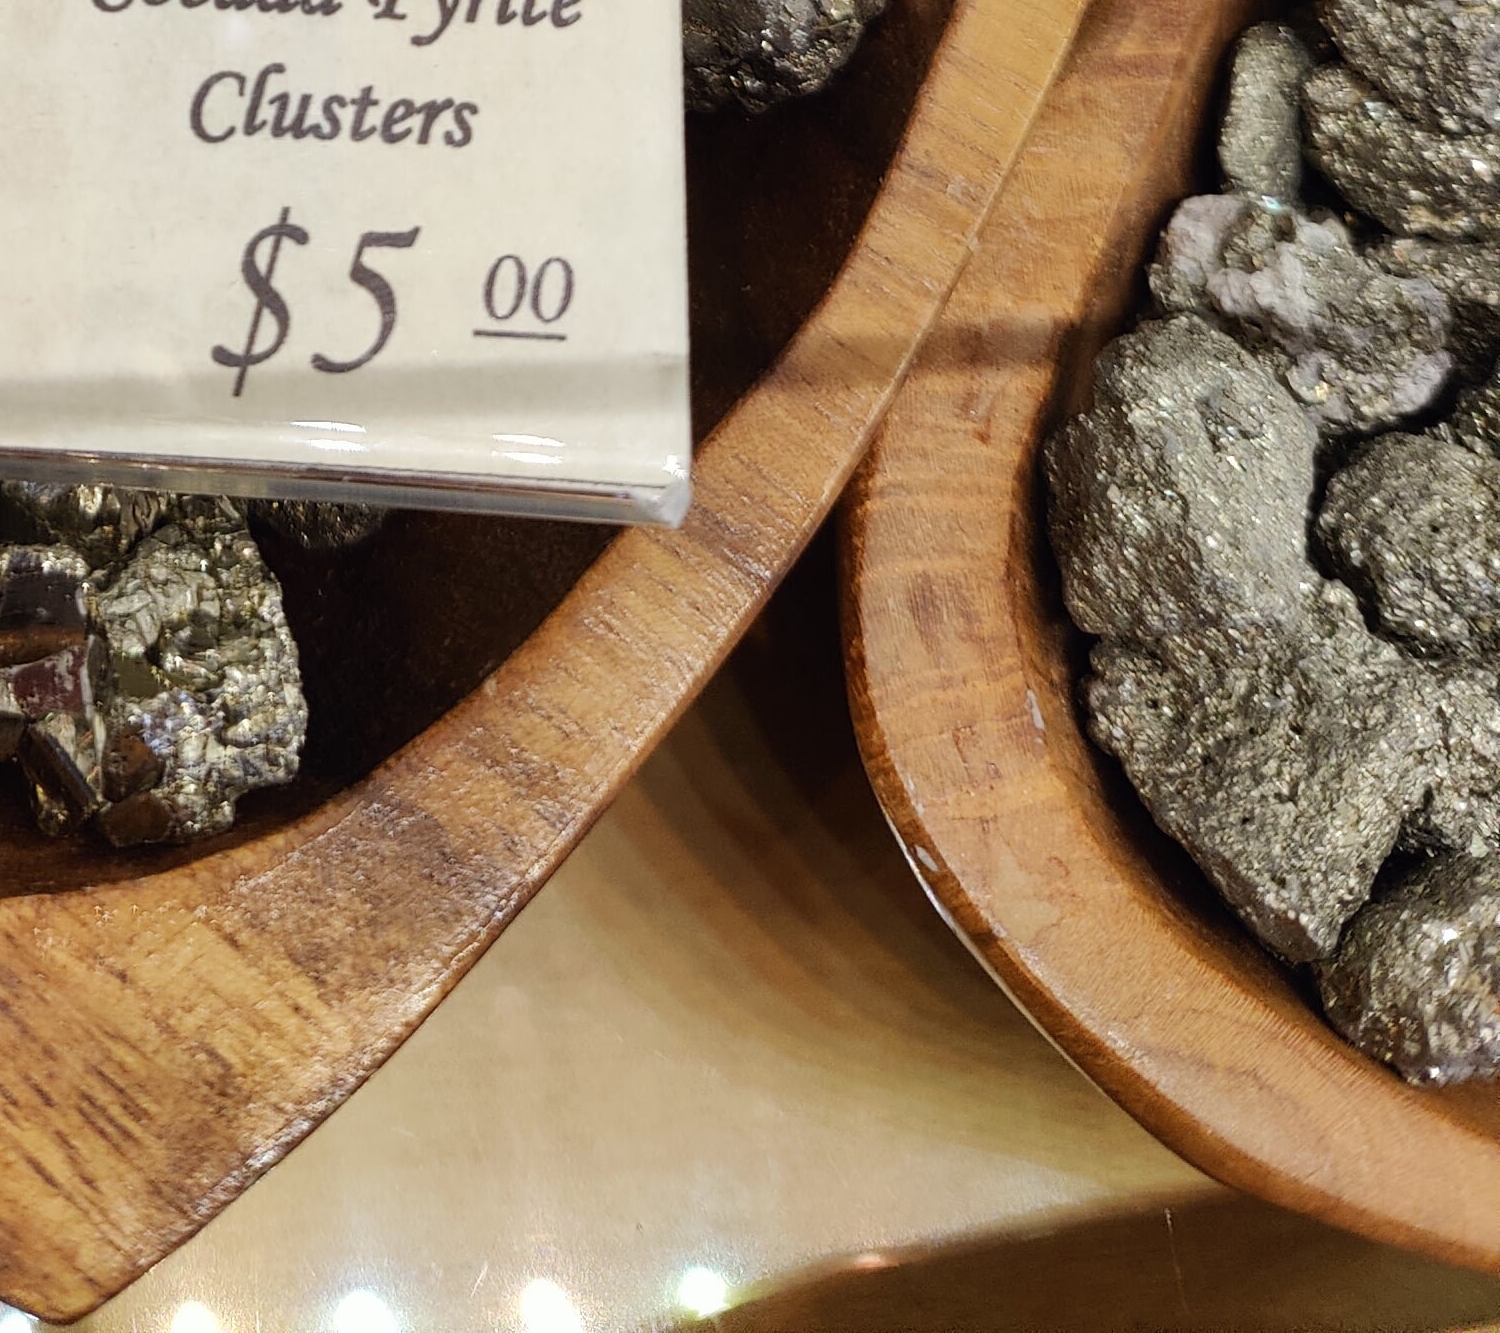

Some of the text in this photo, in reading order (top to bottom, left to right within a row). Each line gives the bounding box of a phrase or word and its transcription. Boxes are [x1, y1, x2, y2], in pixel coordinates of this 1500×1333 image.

[189, 62, 479, 149] Clusters
[211, 206, 575, 399] $5 00
